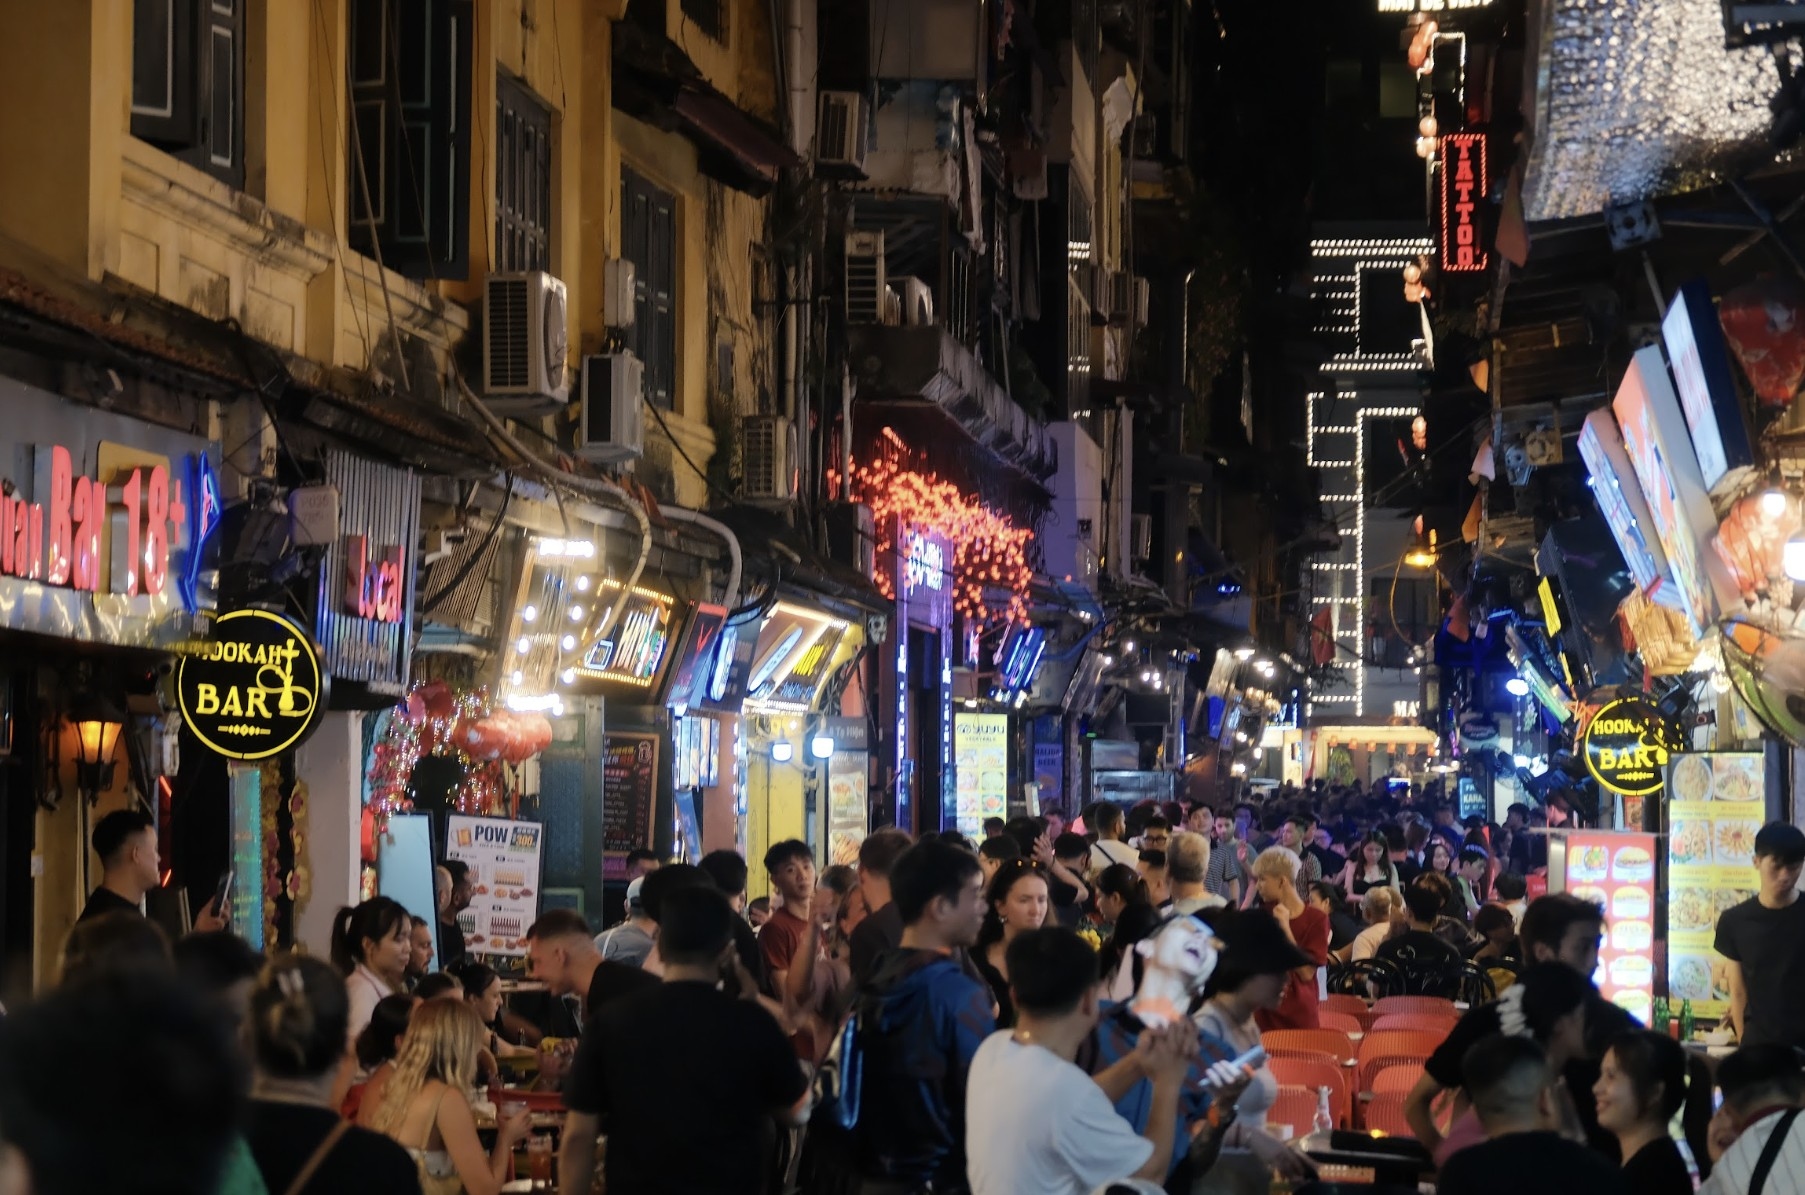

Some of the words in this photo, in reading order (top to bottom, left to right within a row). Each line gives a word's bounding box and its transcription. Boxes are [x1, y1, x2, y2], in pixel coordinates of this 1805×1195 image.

[1455, 139, 1474, 265] TATTOO
[0, 480, 43, 579] uan
[49, 445, 106, 592] Bar
[122, 464, 186, 597] 18+
[196, 683, 272, 719] BAR
[1594, 718, 1649, 735] HOOKA
[1600, 747, 1654, 770] BAR
[474, 825, 508, 843] POW
